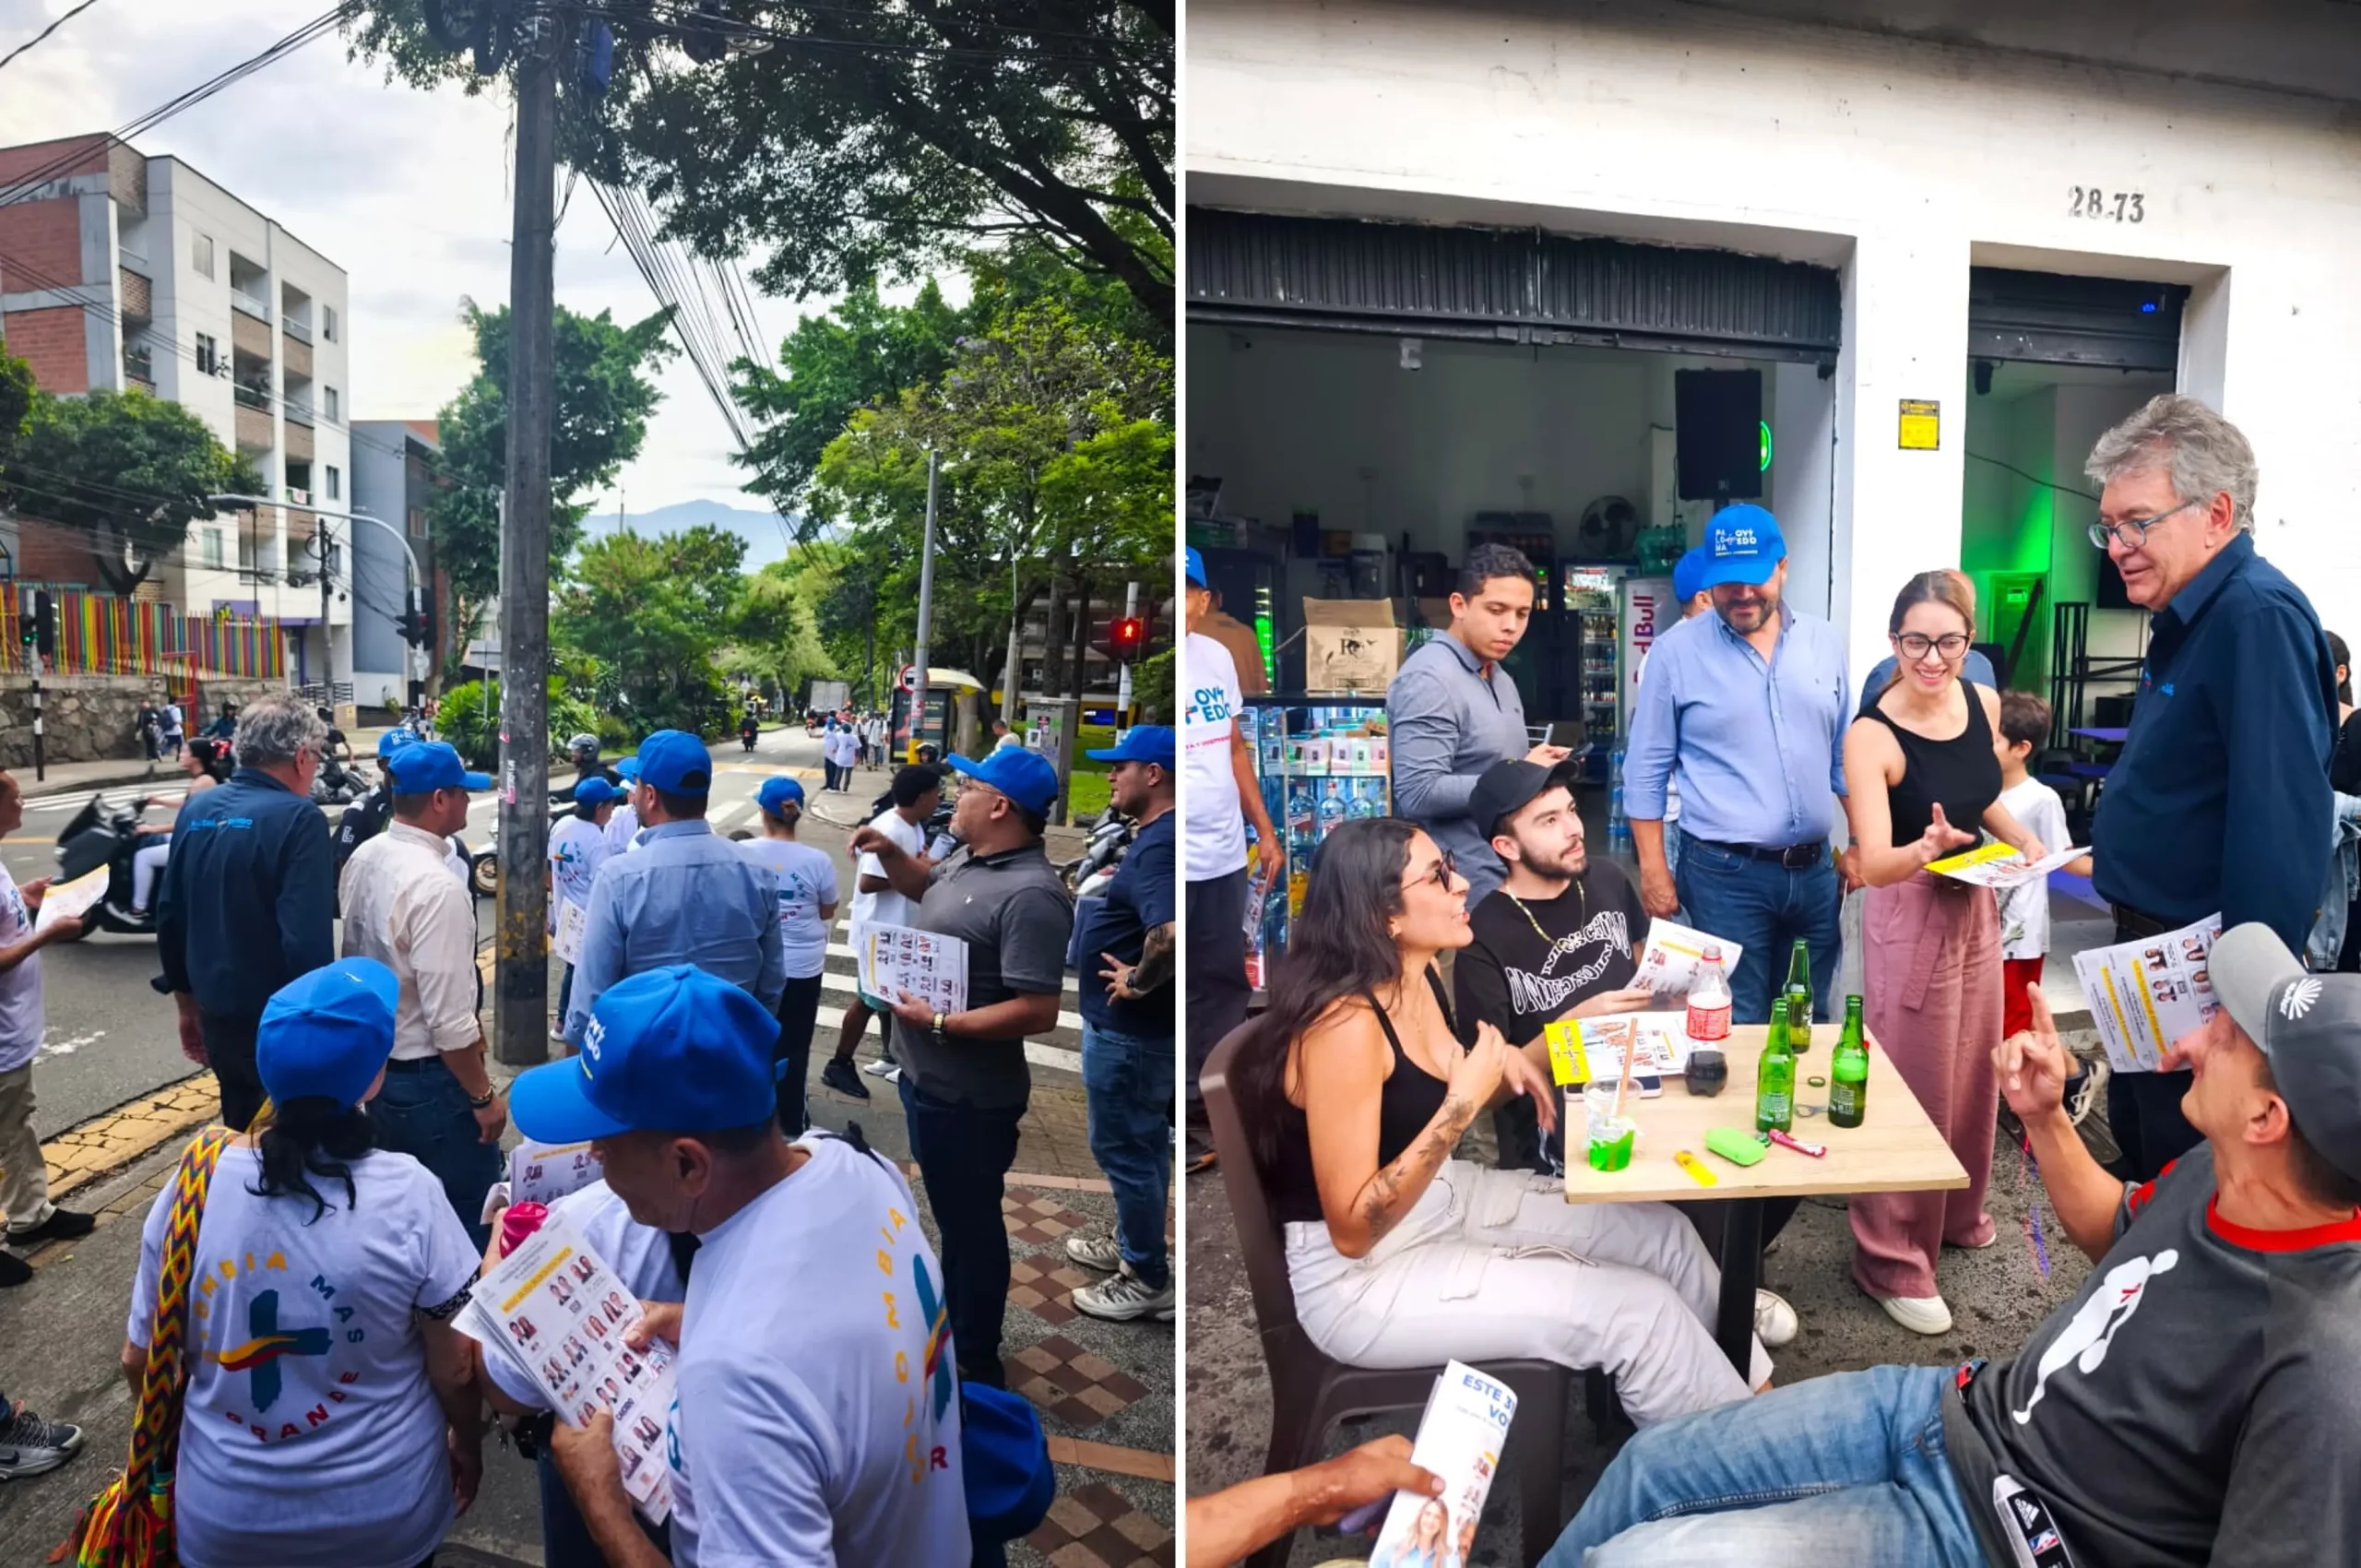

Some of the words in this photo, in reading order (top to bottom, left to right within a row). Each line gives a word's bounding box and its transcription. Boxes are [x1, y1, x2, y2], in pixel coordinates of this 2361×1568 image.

[1633, 596, 1655, 637] Bull
[310, 1274, 366, 1344] MAS
[1462, 1373, 1502, 1402] ESTE
[2014, 1498, 2033, 1530] adidas
